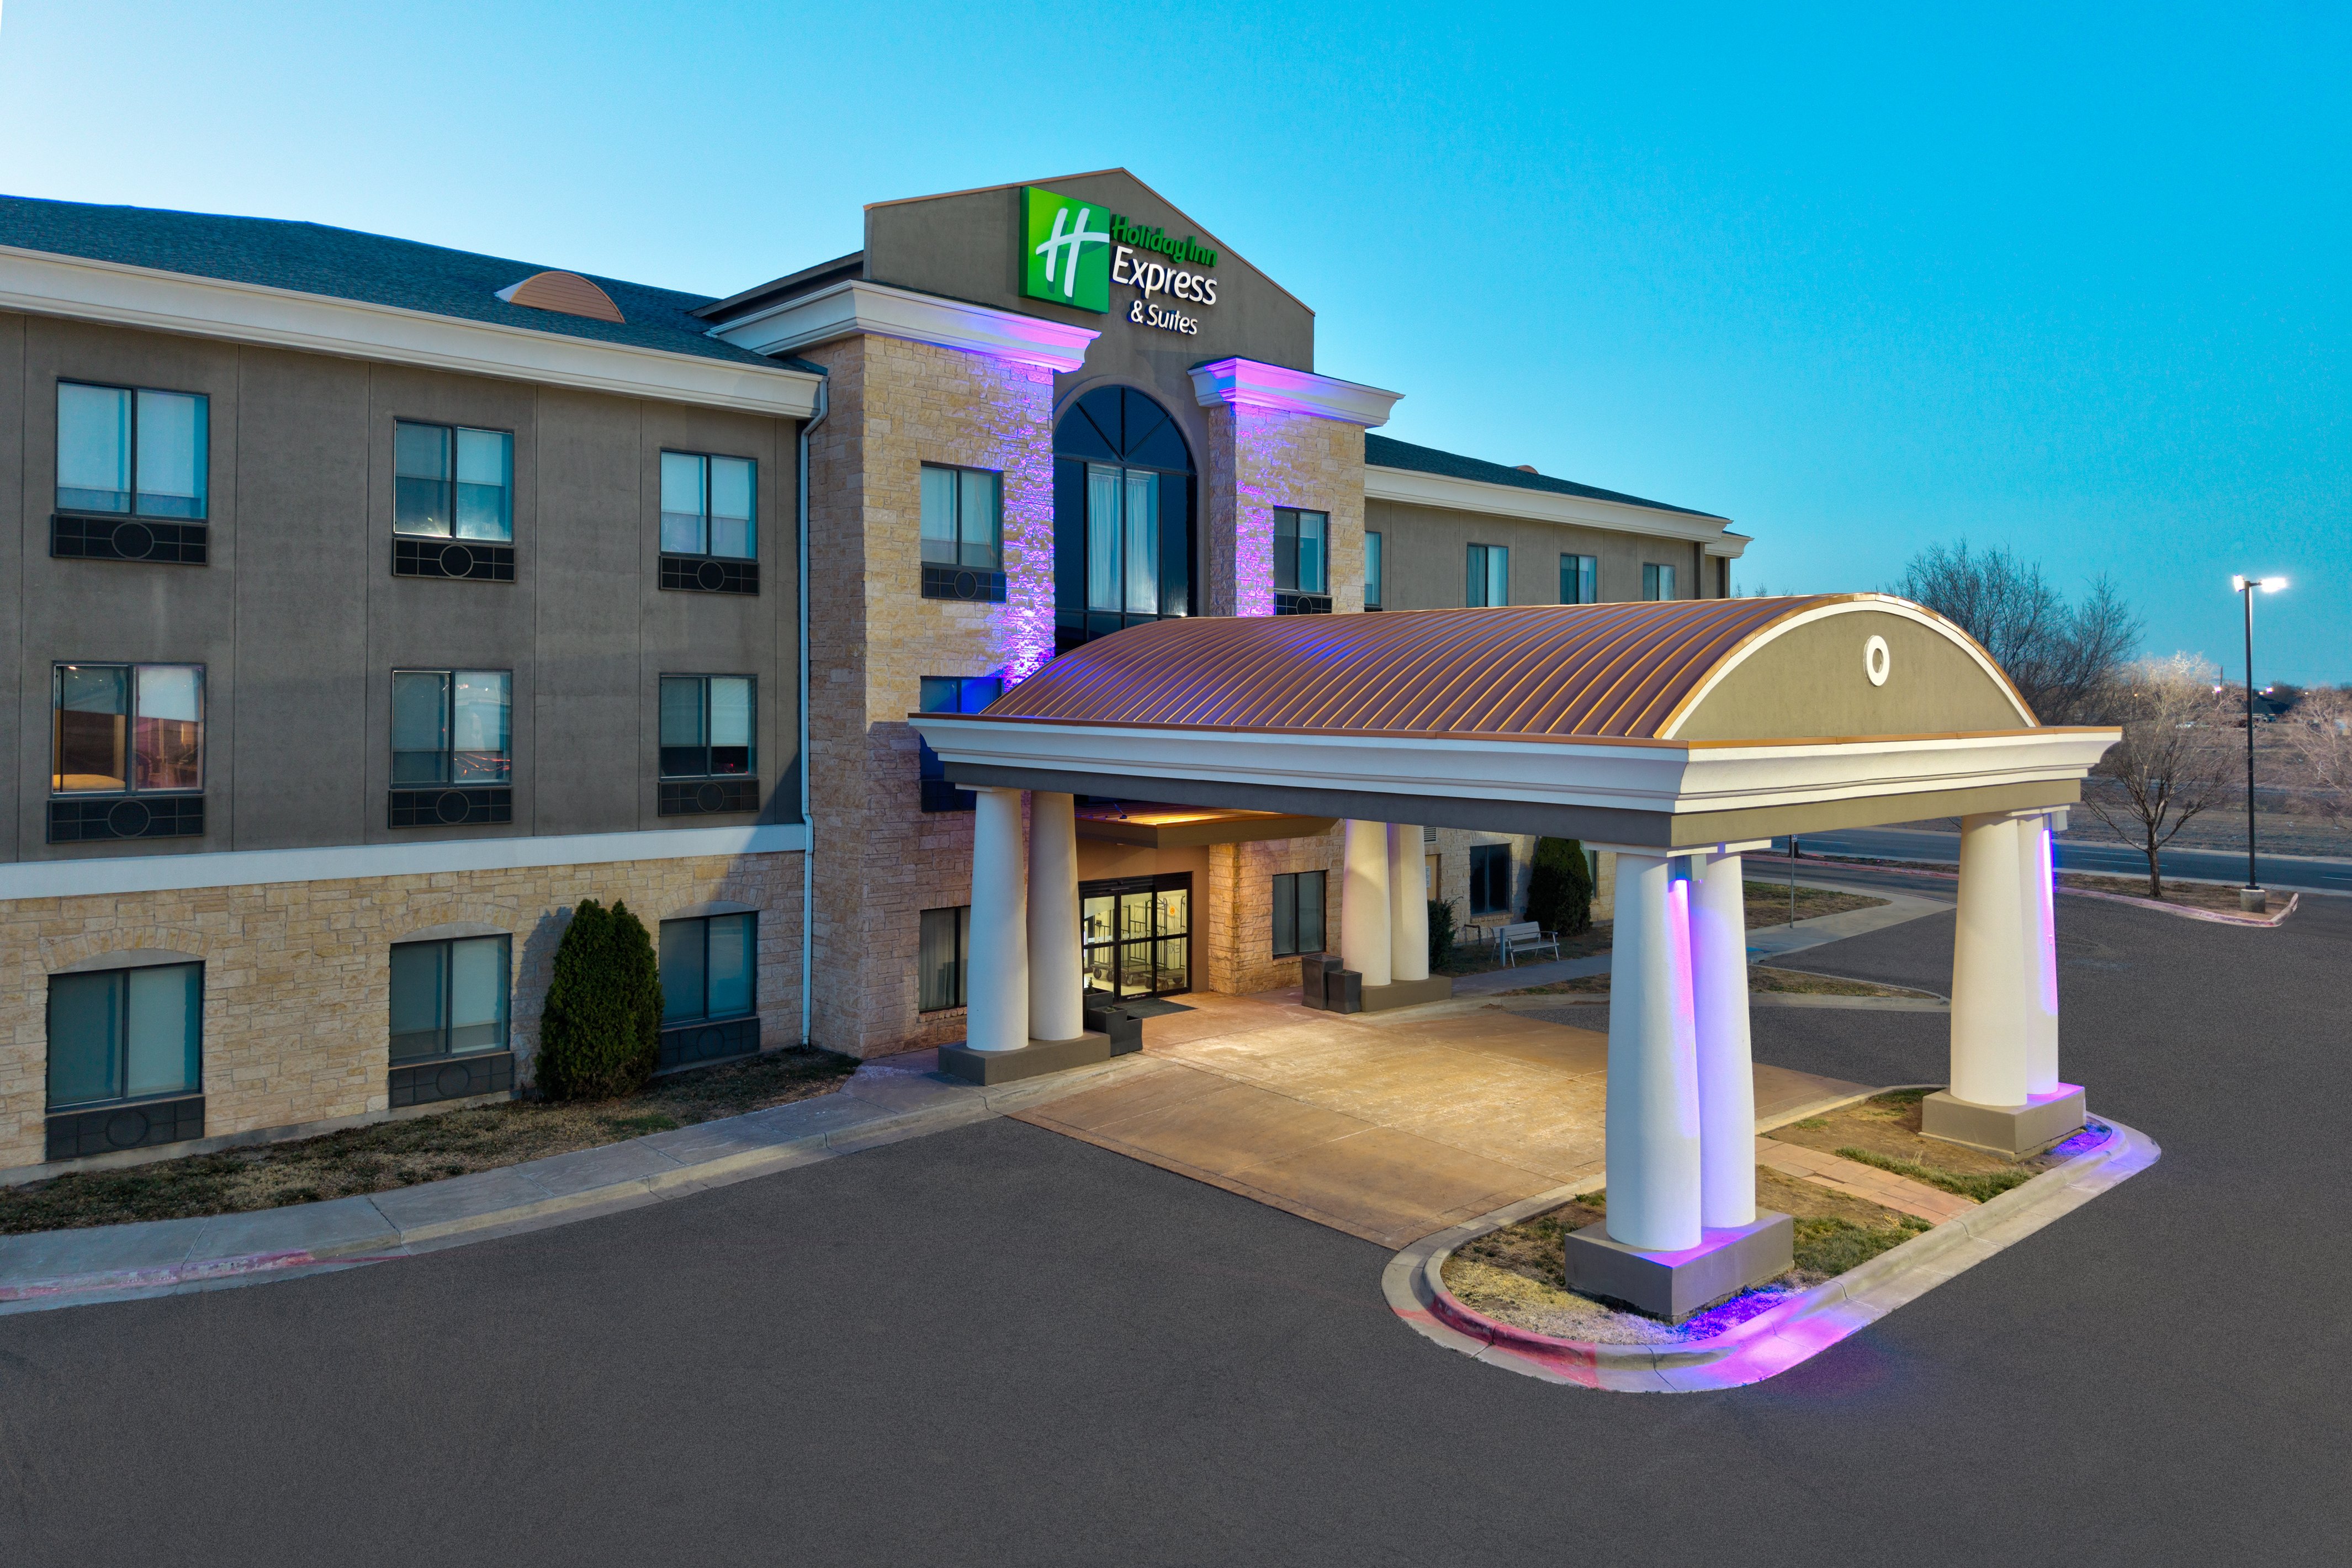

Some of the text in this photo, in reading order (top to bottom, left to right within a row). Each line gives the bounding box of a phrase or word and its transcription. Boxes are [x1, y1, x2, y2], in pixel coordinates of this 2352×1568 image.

[1111, 214, 1218, 267] Holiday Inn
[1111, 245, 1218, 305] Express
[1129, 300, 1198, 335] & Suites
